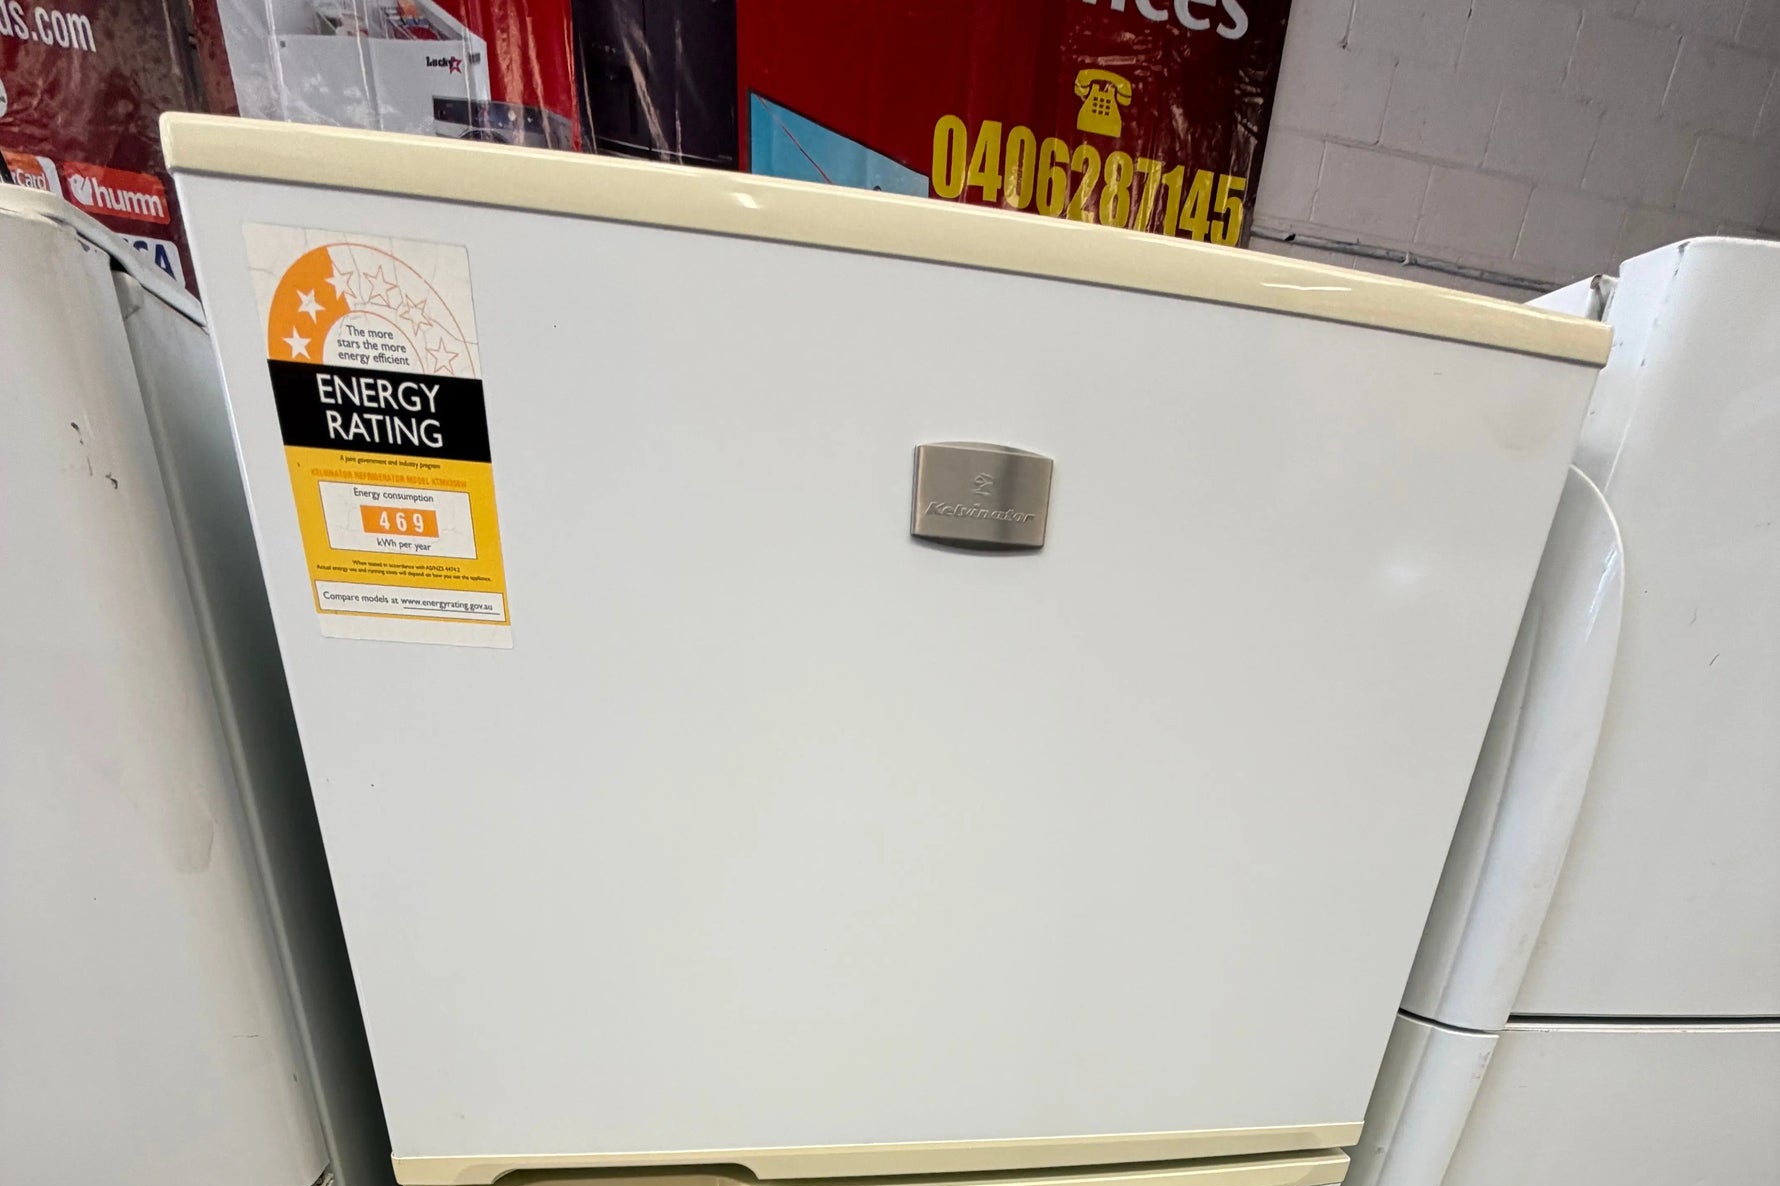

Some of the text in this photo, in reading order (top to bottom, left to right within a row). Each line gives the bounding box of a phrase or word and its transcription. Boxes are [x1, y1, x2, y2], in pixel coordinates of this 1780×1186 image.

[931, 114, 1247, 249] 0406287145
[92, 177, 165, 218] humm
[346, 324, 394, 340] The more
[337, 339, 406, 353] stars the more
[338, 352, 410, 366] energy efficient
[316, 373, 440, 413] ENERGY
[326, 410, 444, 448] RATING
[353, 487, 434, 503] Energy consumption
[925, 501, 1036, 524] Kelvinator
[377, 537, 431, 552] kWh per year
[323, 591, 360, 603] Compare
[361, 594, 389, 604] models
[400, 598, 493, 611] www.energyrating.gov.au
